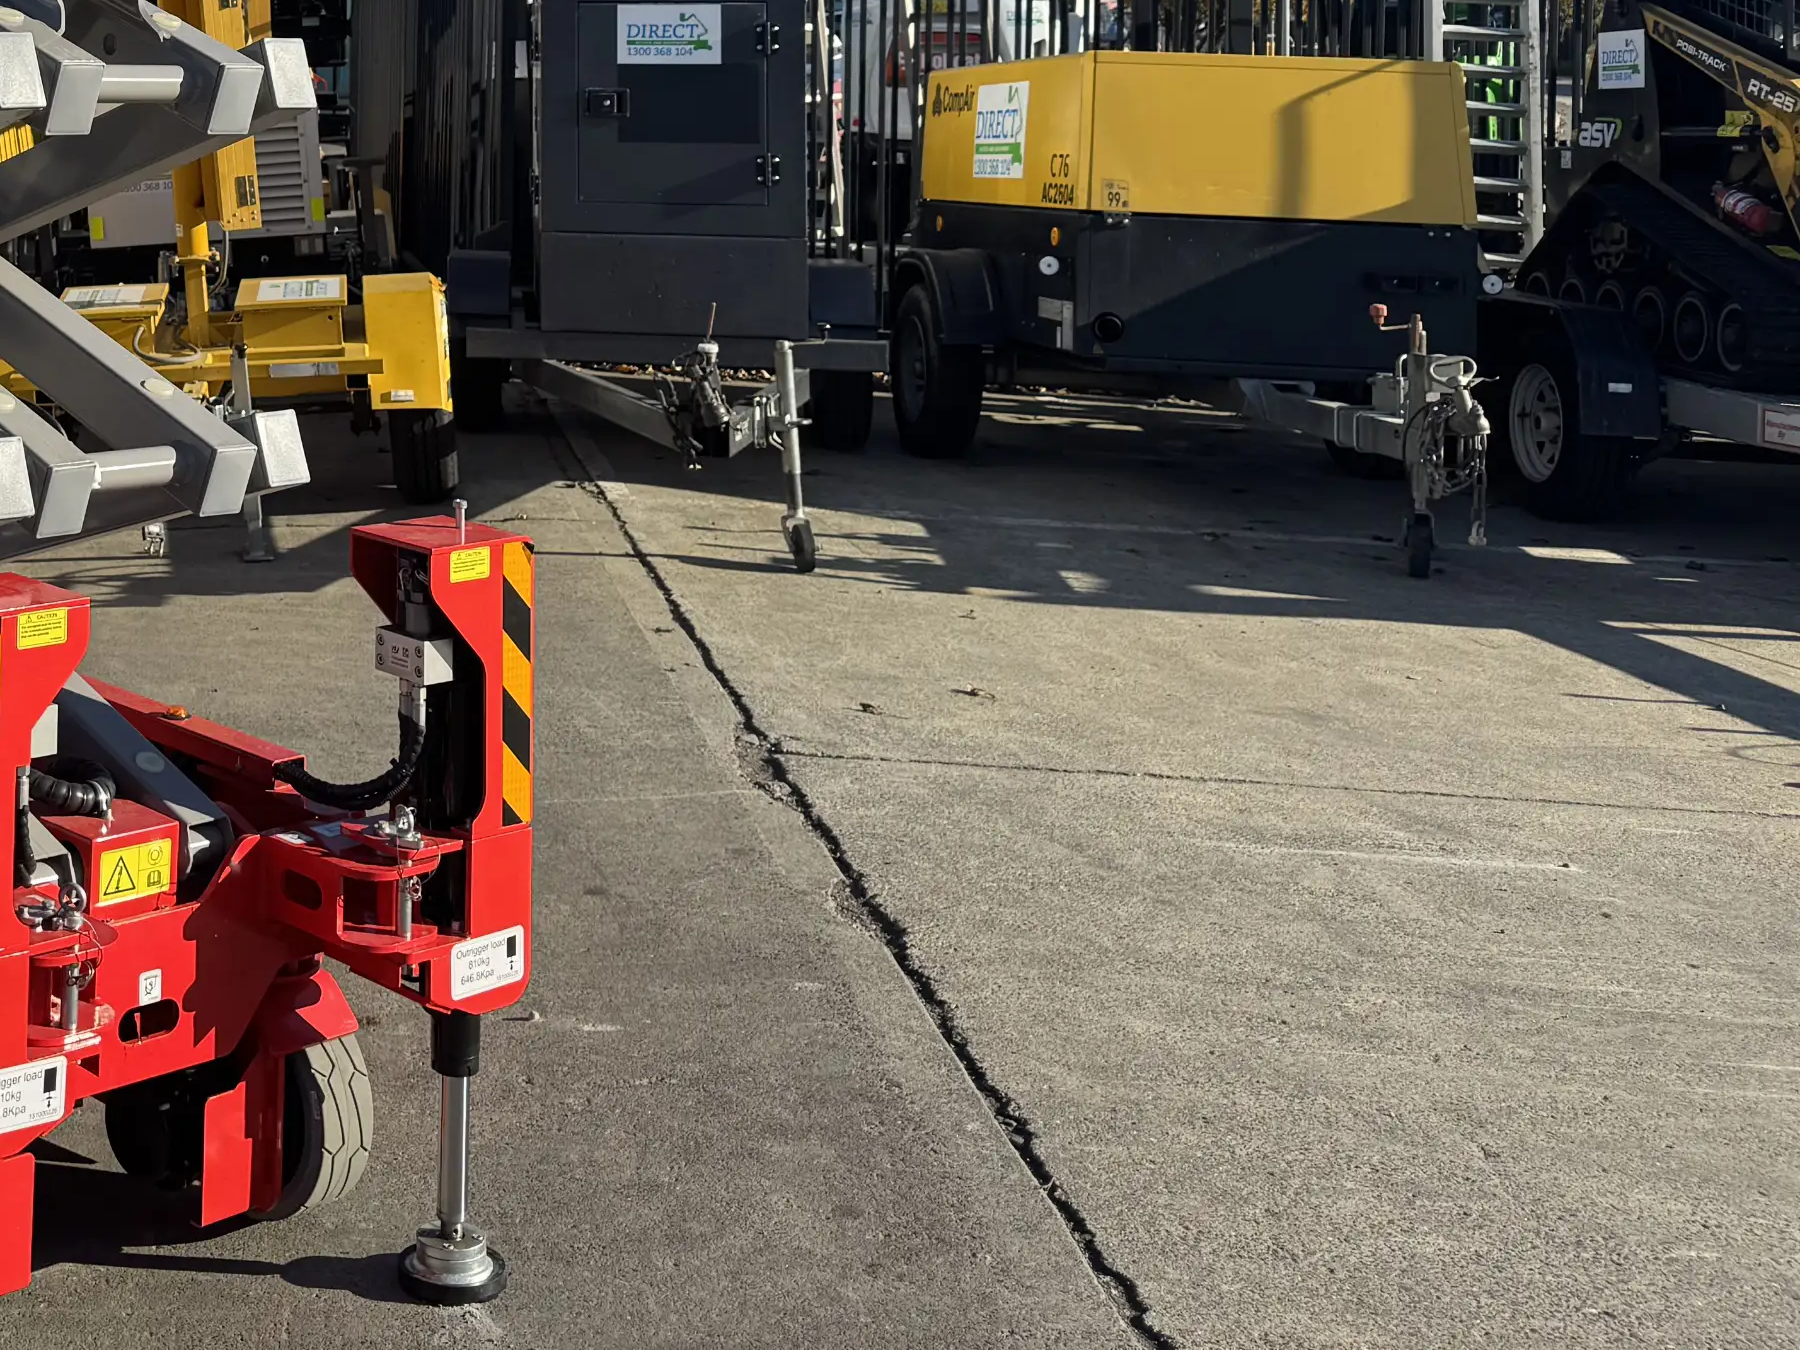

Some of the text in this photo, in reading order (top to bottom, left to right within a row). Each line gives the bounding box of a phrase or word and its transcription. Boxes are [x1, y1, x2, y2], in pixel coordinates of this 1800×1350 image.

[627, 24, 699, 38] DIRECT
[628, 47, 693, 56] 1300 368 104
[1602, 49, 1635, 65] DIRECT
[1676, 39, 1726, 71] POSI-TRACK
[943, 84, 975, 117] CompAir
[1747, 78, 1795, 113] RT-25
[976, 109, 1018, 139] DIRECT
[1108, 191, 1121, 207] 99
[456, 937, 506, 960] Outrigger load
[468, 956, 490, 969] 810kg
[23, 1070, 43, 1083] load
